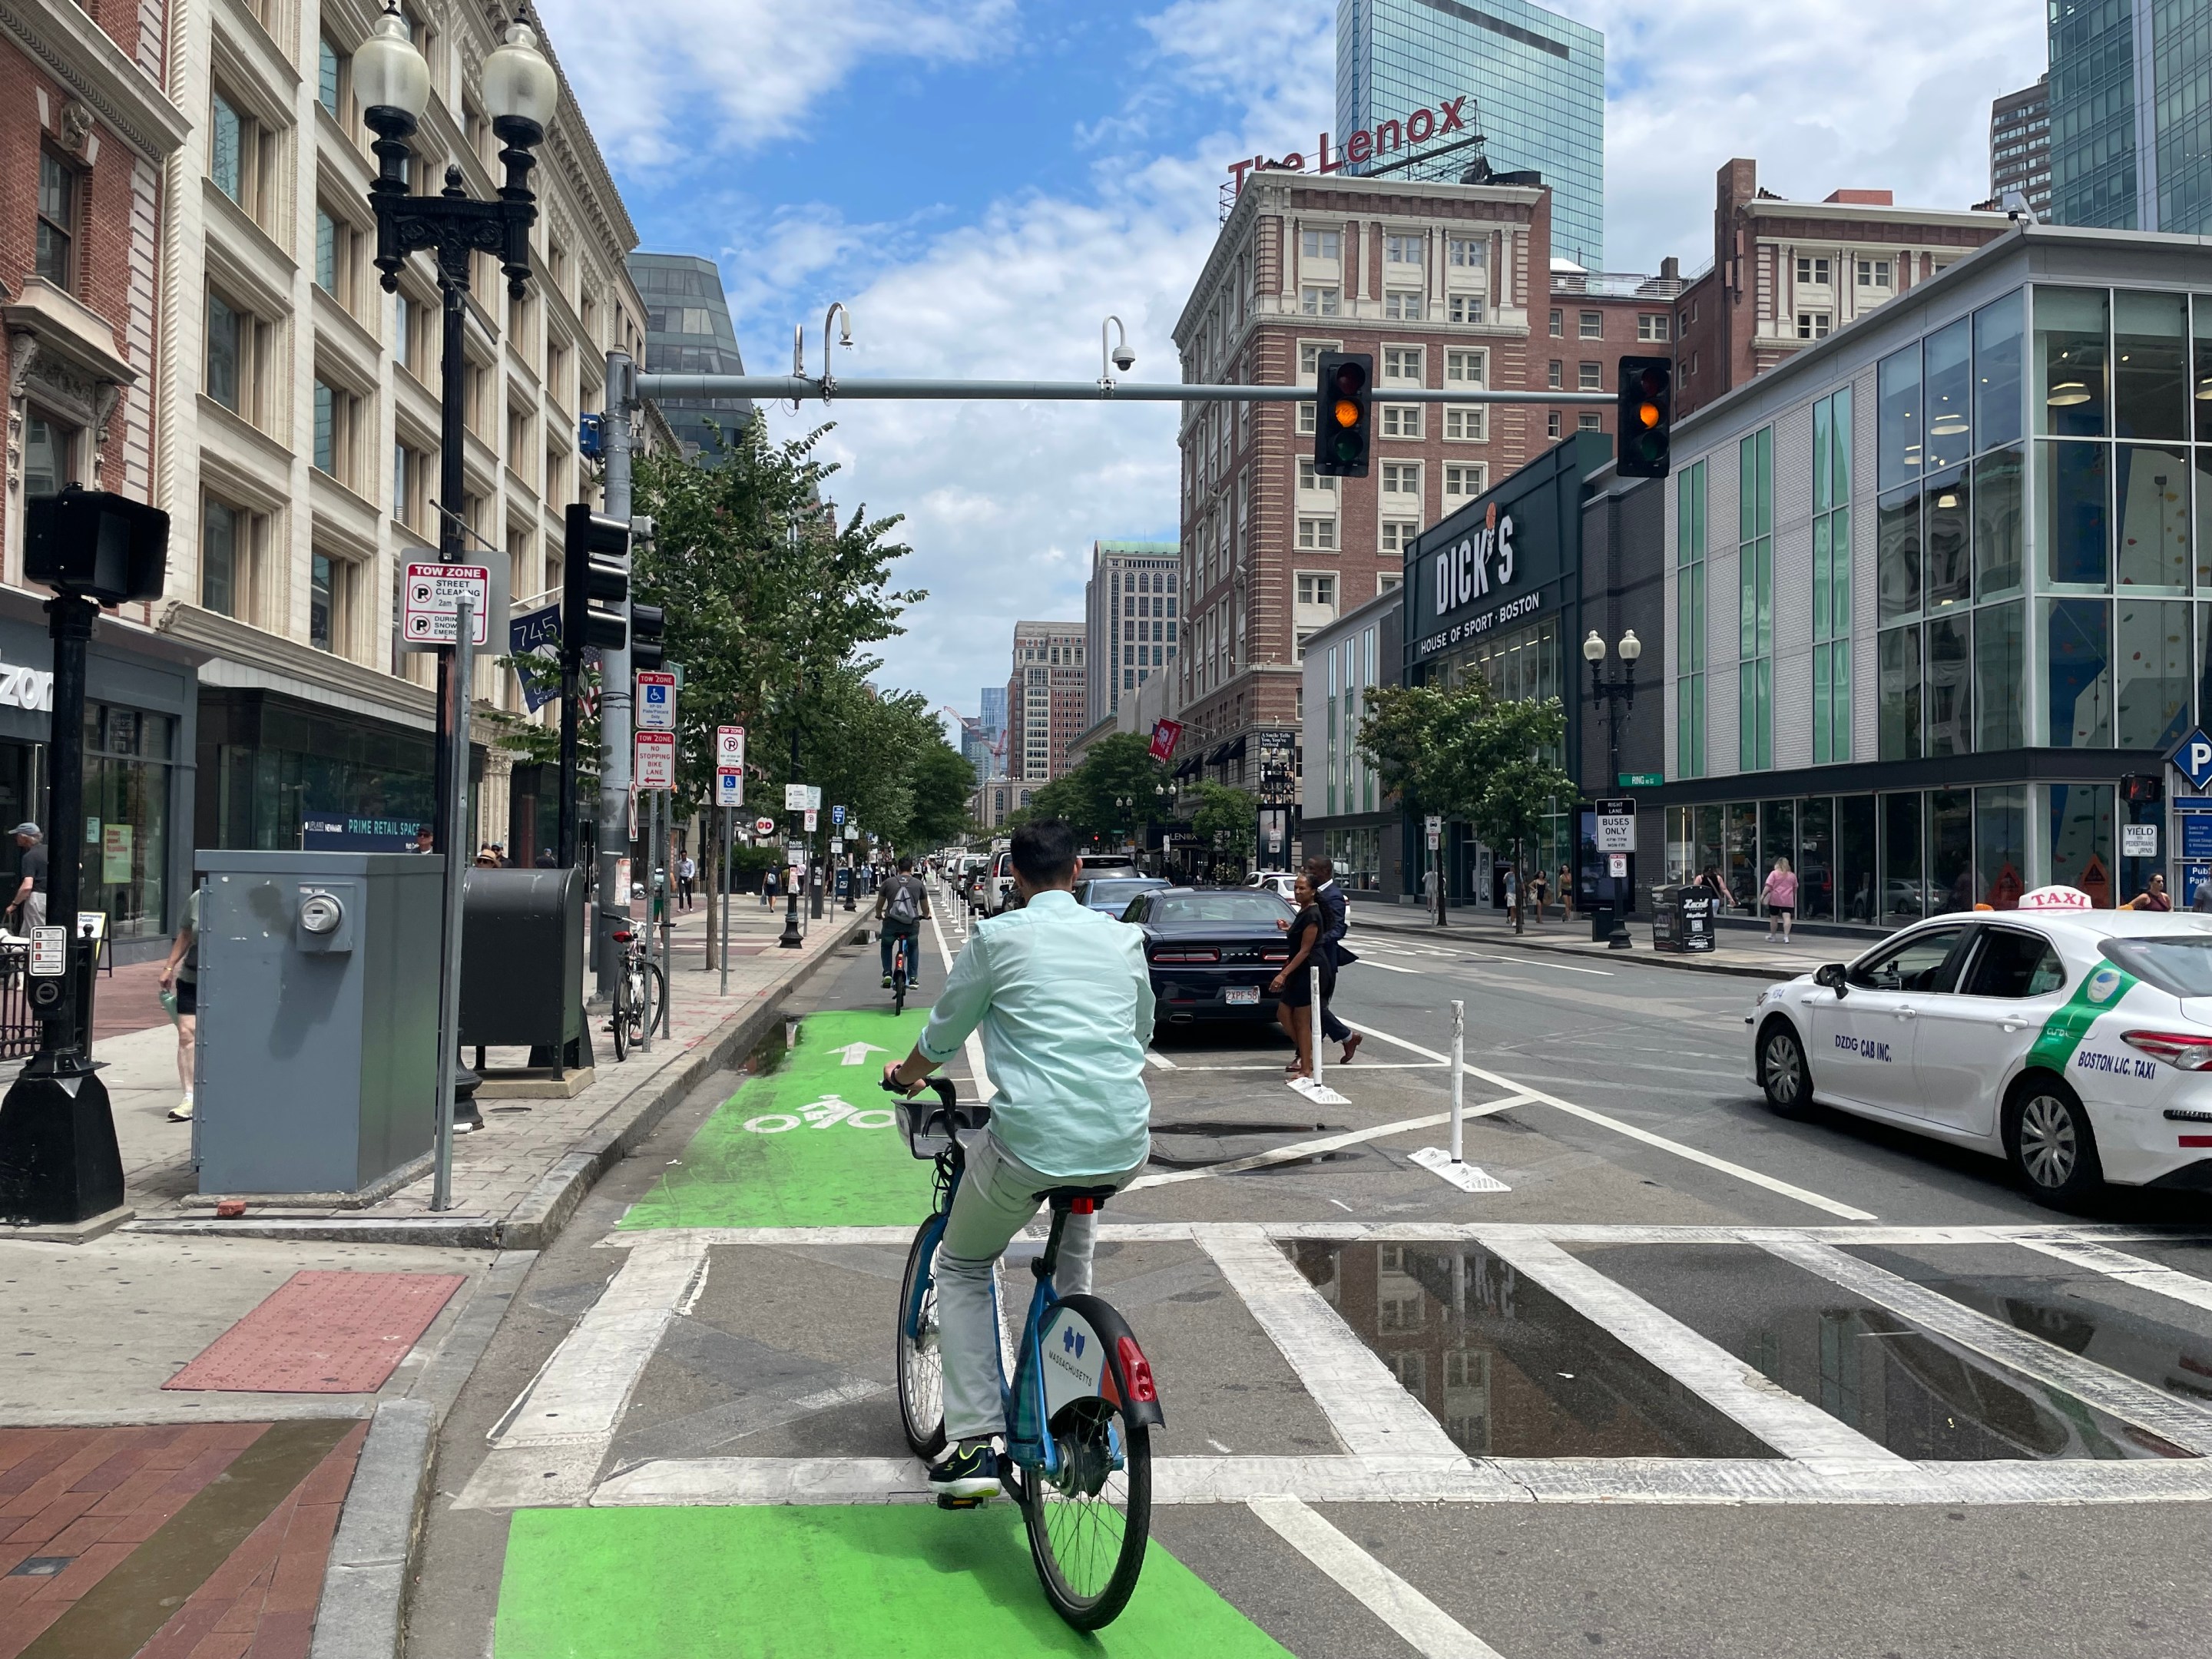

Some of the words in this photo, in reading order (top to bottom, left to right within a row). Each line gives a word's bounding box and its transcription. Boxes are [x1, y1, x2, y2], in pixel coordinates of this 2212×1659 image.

[1320, 95, 1467, 175] Lenox
[415, 566, 444, 576] TOW
[446, 568, 481, 578] ZONE
[1436, 515, 1513, 615] DICK'S
[435, 588, 480, 597] CLEANNG
[514, 616, 558, 647] 745
[1421, 632, 1447, 655] HOUSE
[1450, 626, 1462, 643] OF
[1464, 612, 1493, 637] SPORT
[1499, 592, 1539, 623] BOSTON
[655, 675, 673, 684] ZONE
[2190, 743, 2212, 775] P
[1631, 776, 1645, 784] RING
[348, 819, 372, 835] PRIME
[374, 821, 399, 836] RETAIL
[400, 823, 420, 836] SPACE
[2127, 827, 2154, 836] YIELD
[1170, 833, 1198, 841] LENOX
[2032, 892, 2085, 906] TAXI
[1227, 991, 1244, 1000] 2XPF
[1247, 991, 1257, 1000] 58
[1835, 1035, 1858, 1051] DZDG
[1861, 1039, 1875, 1058] CAB
[1876, 1042, 1892, 1062] INC.
[2078, 1051, 2111, 1072] BOSTON
[2114, 1056, 2131, 1075] LIC.
[2134, 1060, 2156, 1079] TAXI
[1048, 1349, 1092, 1387] MASSACHUSETTS
